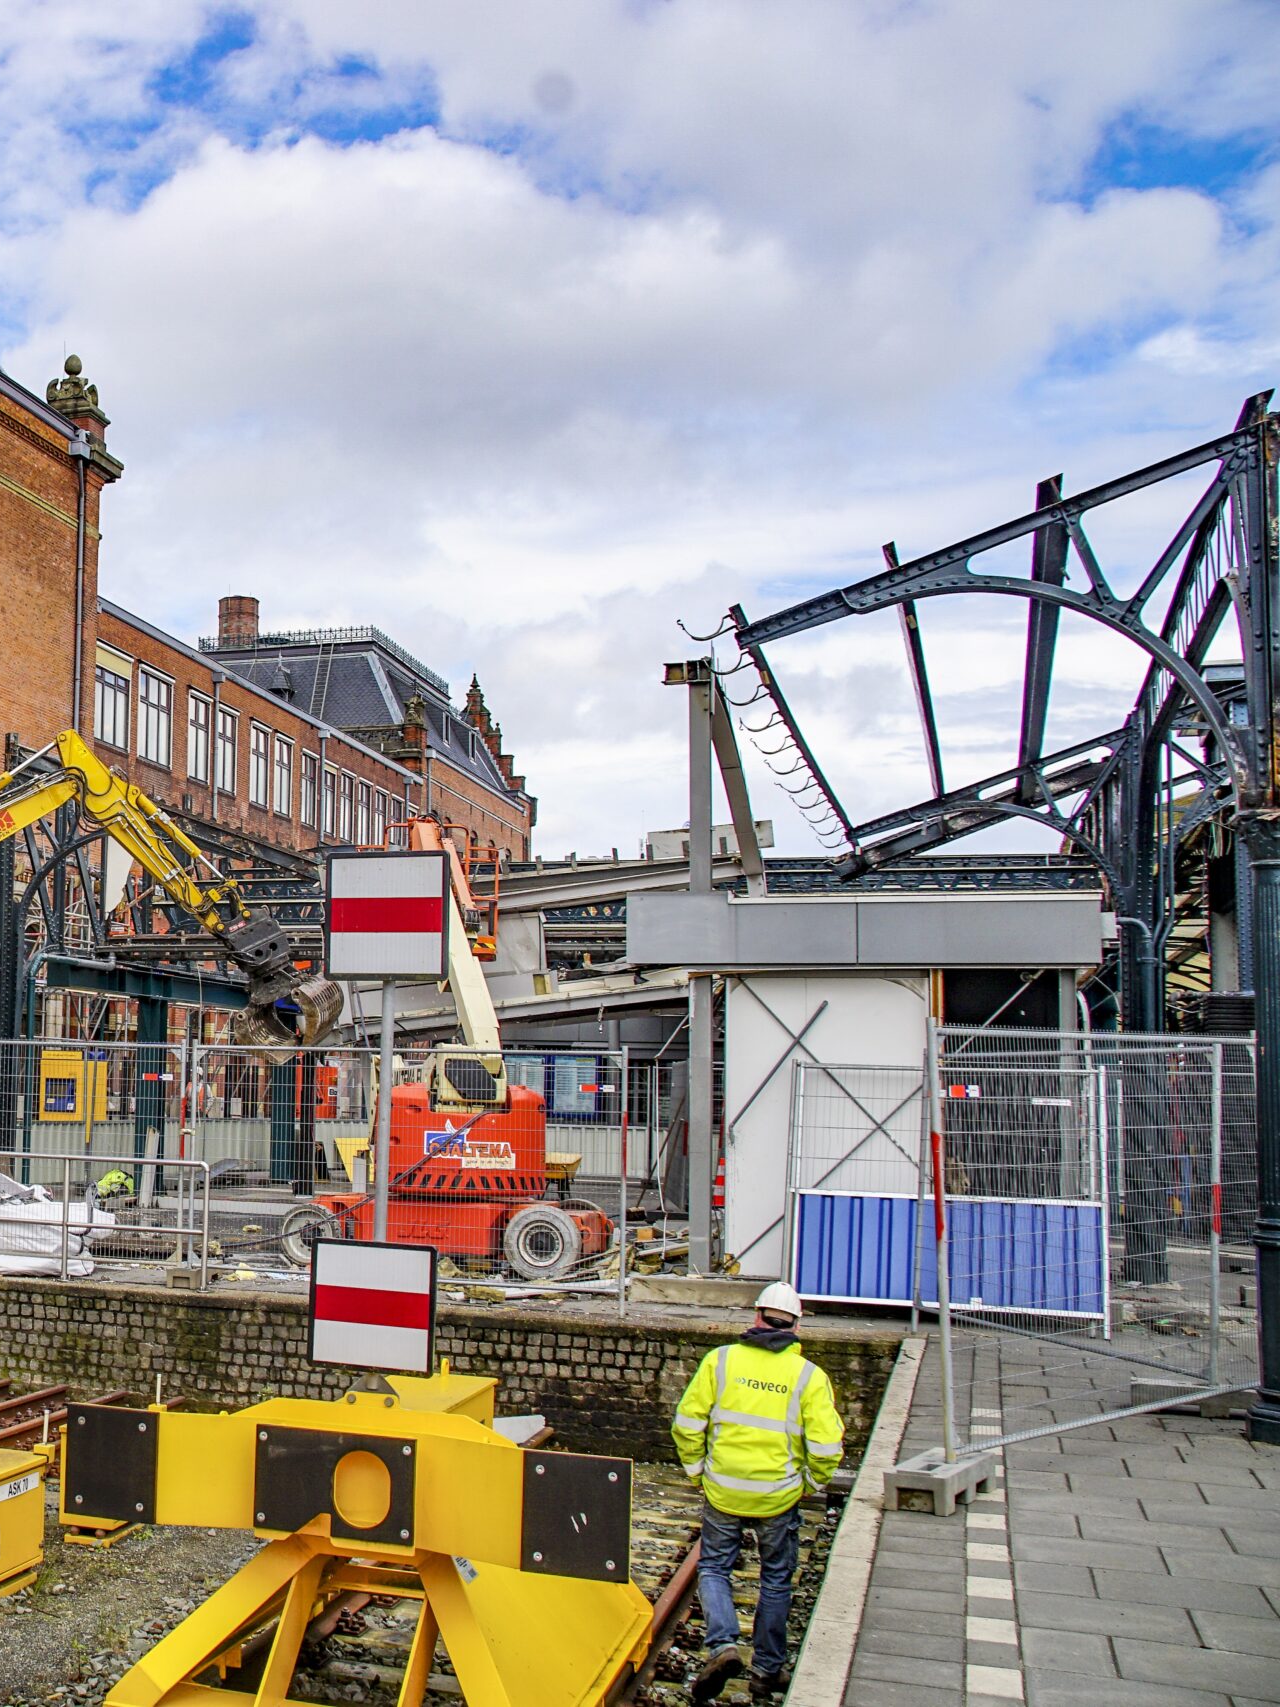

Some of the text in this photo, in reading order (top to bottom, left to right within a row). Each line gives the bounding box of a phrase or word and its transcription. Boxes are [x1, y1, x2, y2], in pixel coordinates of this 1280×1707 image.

[747, 1378, 788, 1394] raveco
[7, 1477, 29, 1498] ASK 70
